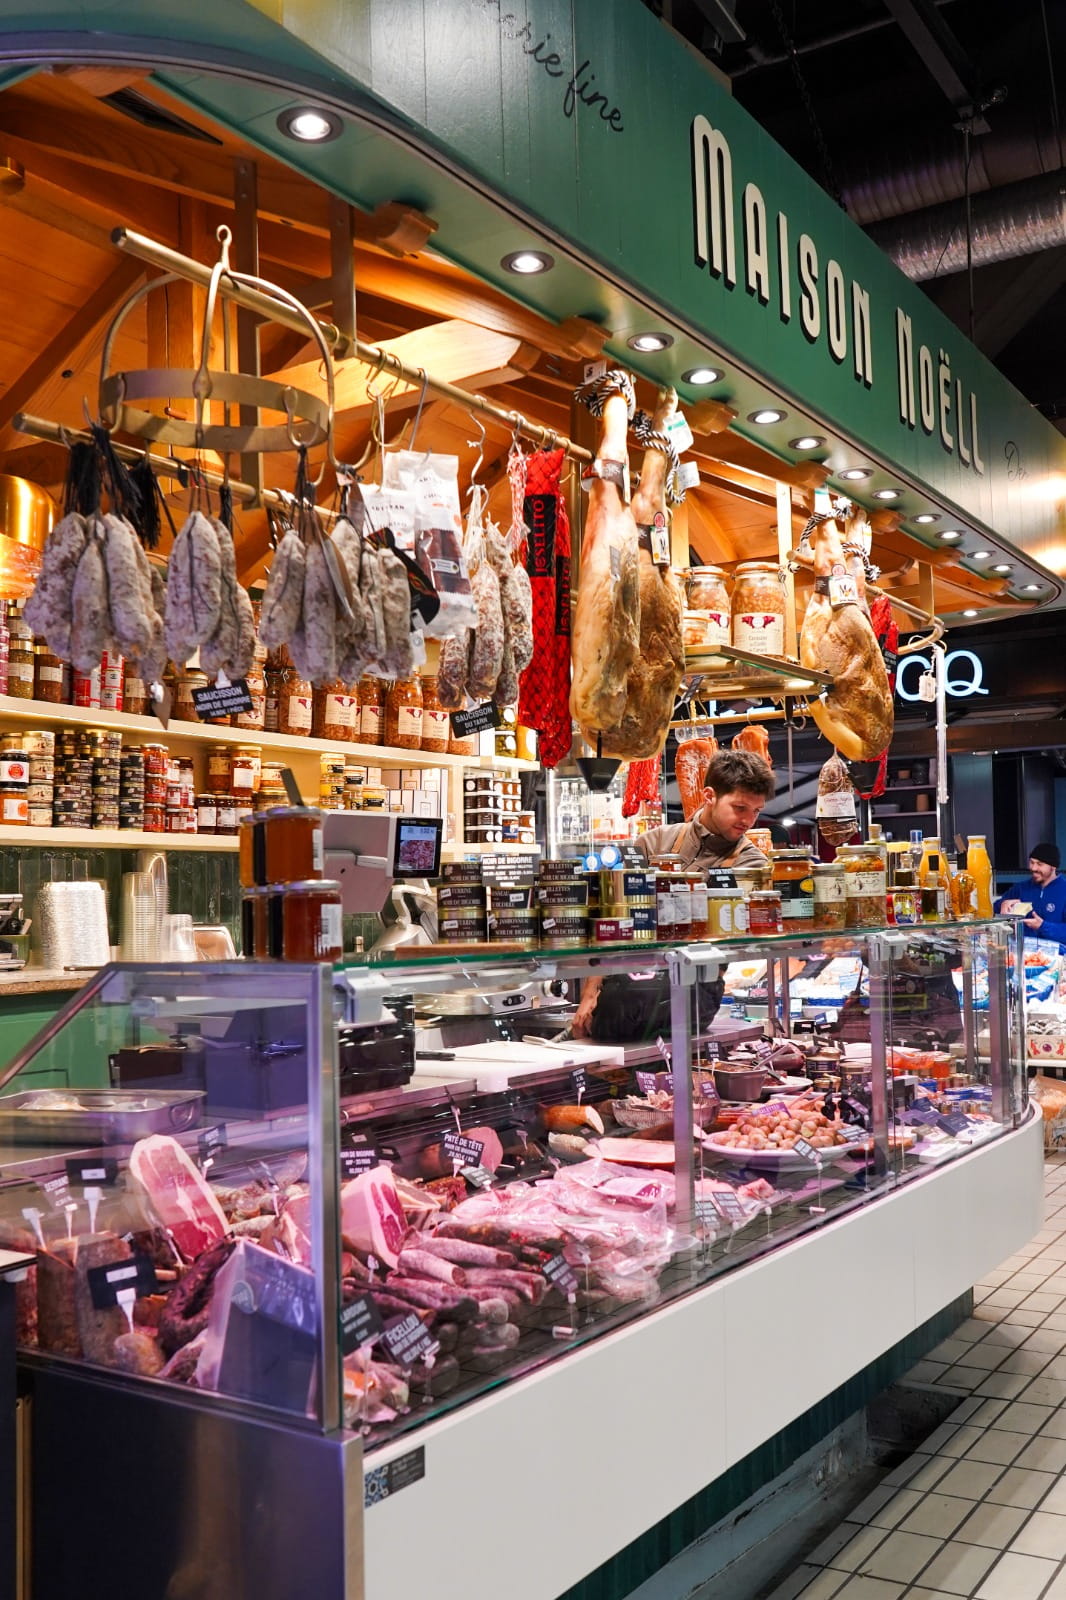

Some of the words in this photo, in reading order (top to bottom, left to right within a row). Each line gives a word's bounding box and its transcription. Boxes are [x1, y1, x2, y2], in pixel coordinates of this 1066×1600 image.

[563, 60, 624, 132] fine
[691, 114, 873, 387] MAISON
[896, 306, 985, 476] NOËLL
[197, 686, 243, 702] SAUCISSON
[212, 700, 223, 709] DE
[455, 706, 493, 723] SAUCISSON
[482, 857, 497, 865] NOIR
[507, 856, 533, 864] BIGORRE
[459, 1137, 468, 1147] DE
